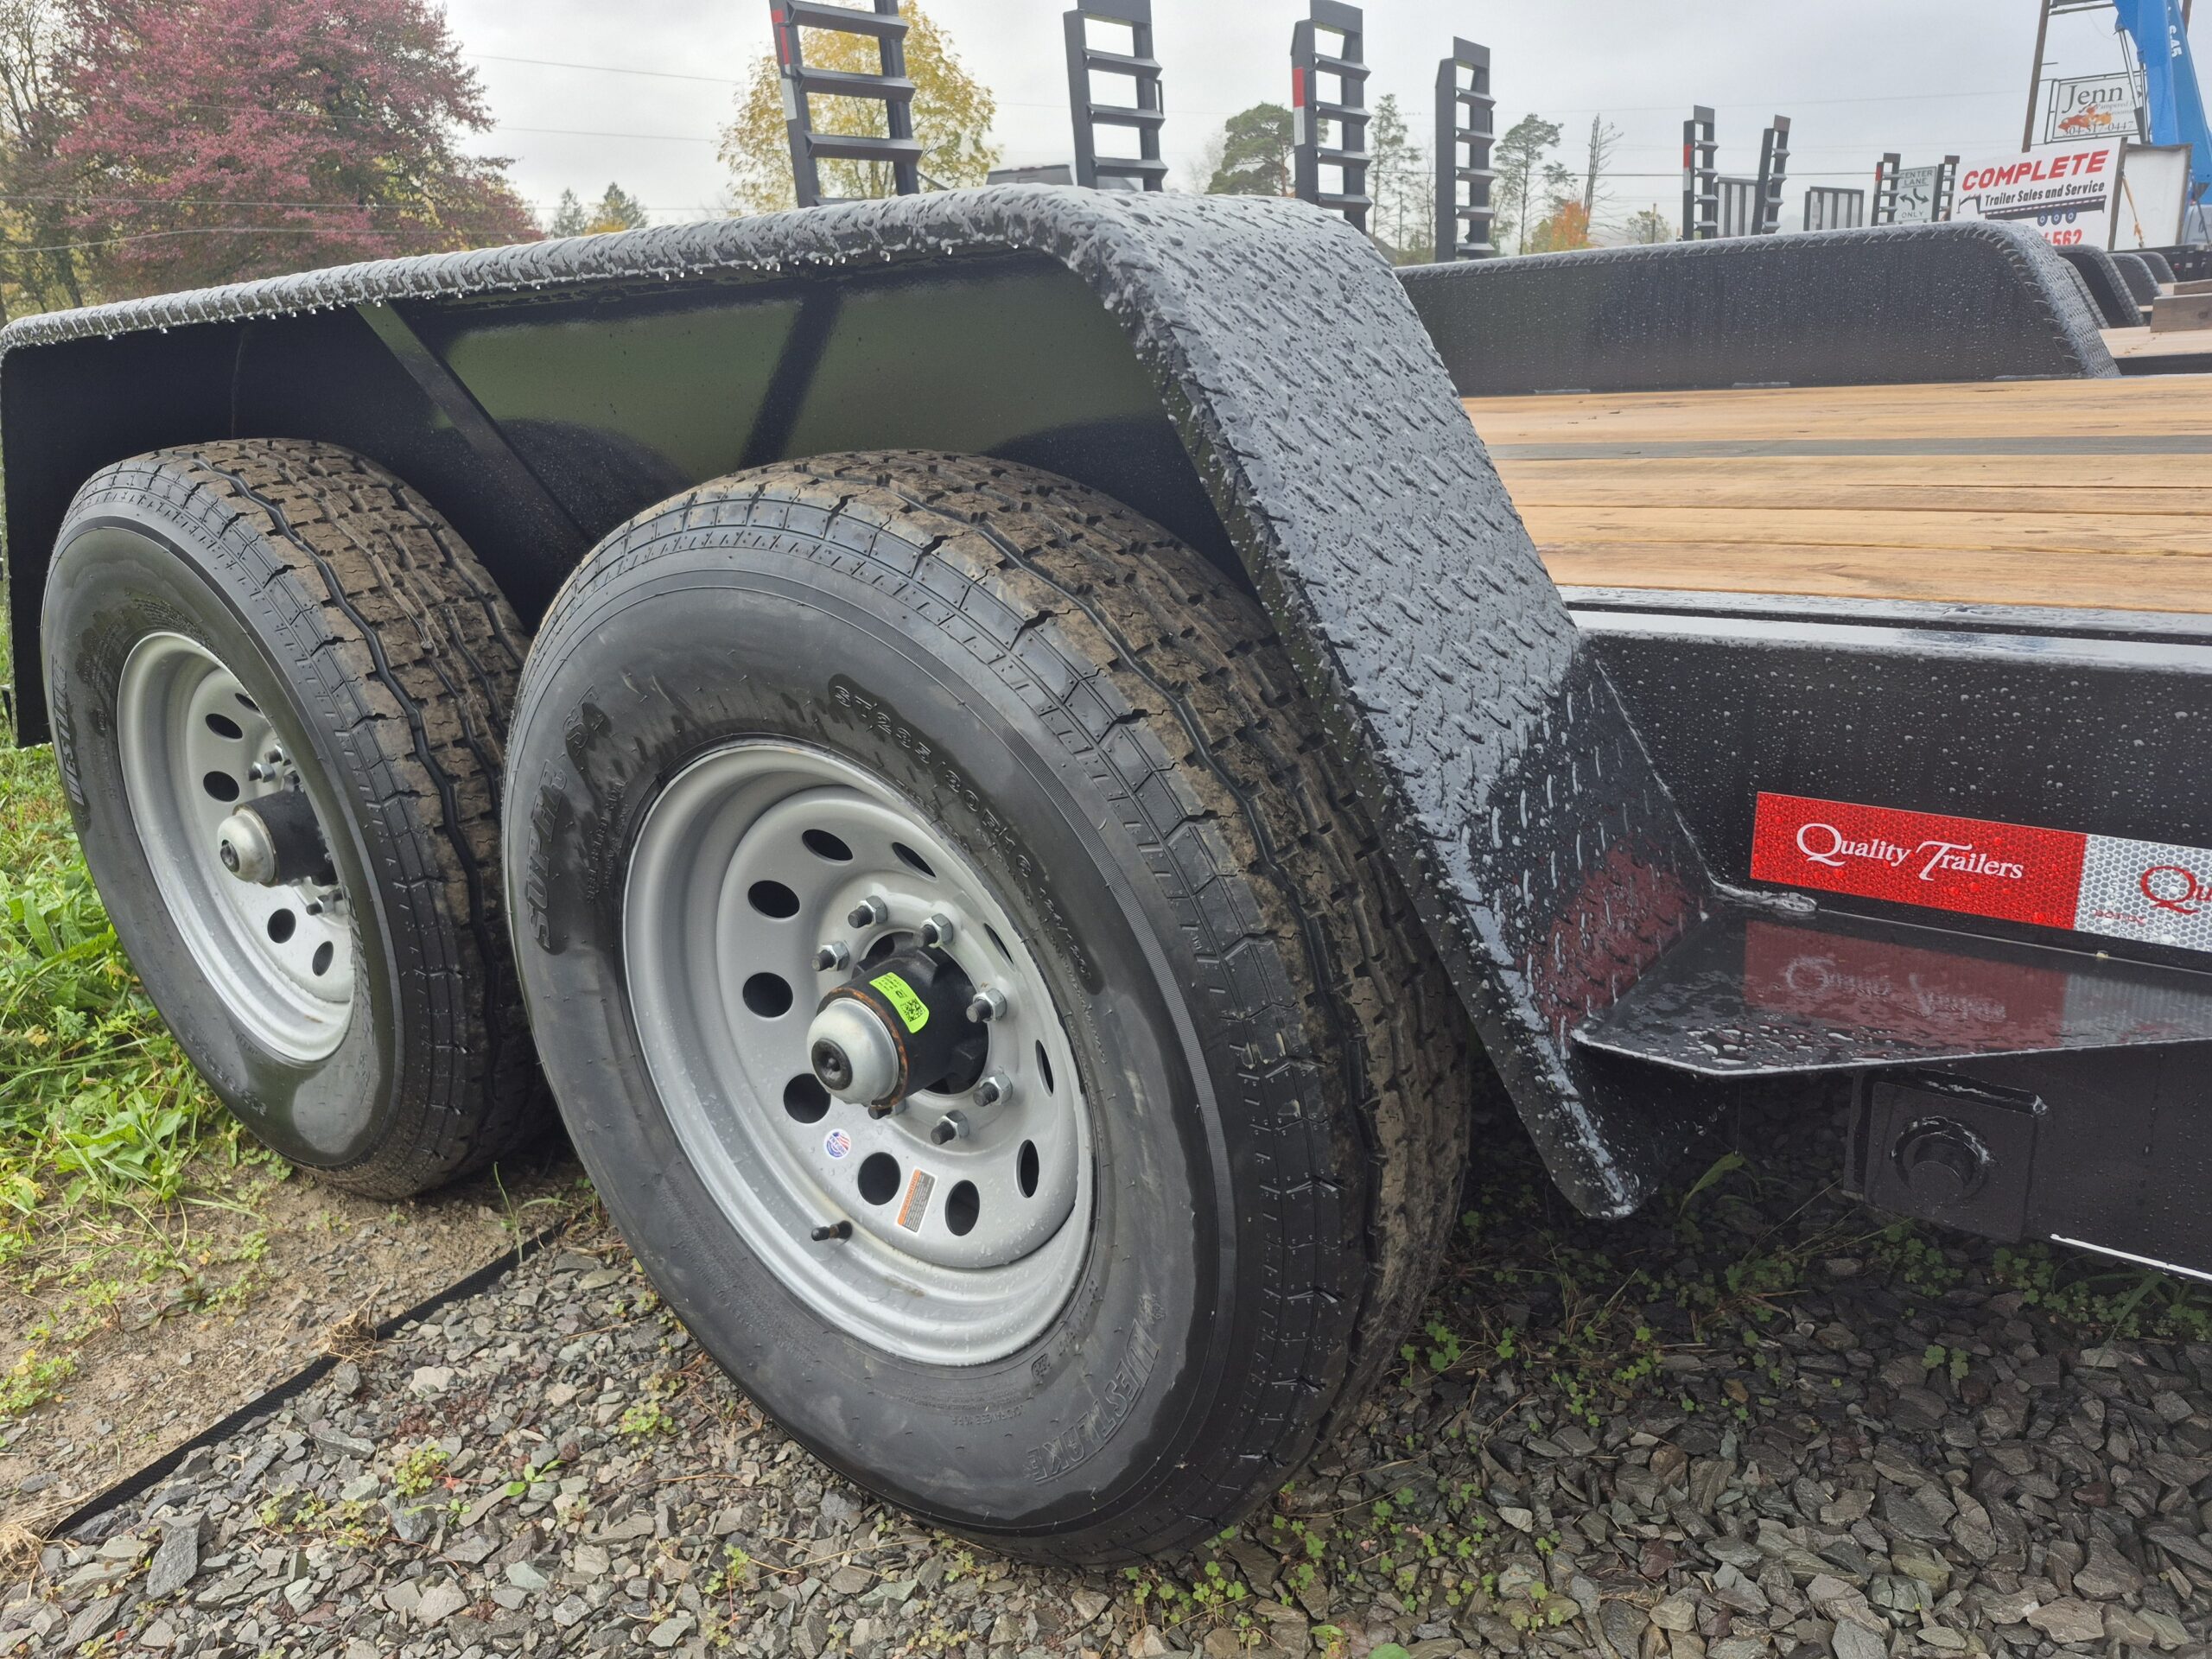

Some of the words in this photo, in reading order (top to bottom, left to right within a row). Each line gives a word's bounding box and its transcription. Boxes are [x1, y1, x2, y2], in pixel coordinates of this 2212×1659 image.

[1904, 177, 1928, 187] LANE
[1961, 149, 2109, 191] COMPLETE
[1986, 192, 2016, 207] Trailer
[2018, 188, 2043, 202] Sales
[2045, 184, 2063, 199] and
[2065, 180, 2105, 195] Service
[2044, 229, 2082, 245] 562
[1796, 823, 1911, 868] Quality
[1916, 840, 2024, 881] Trailers
